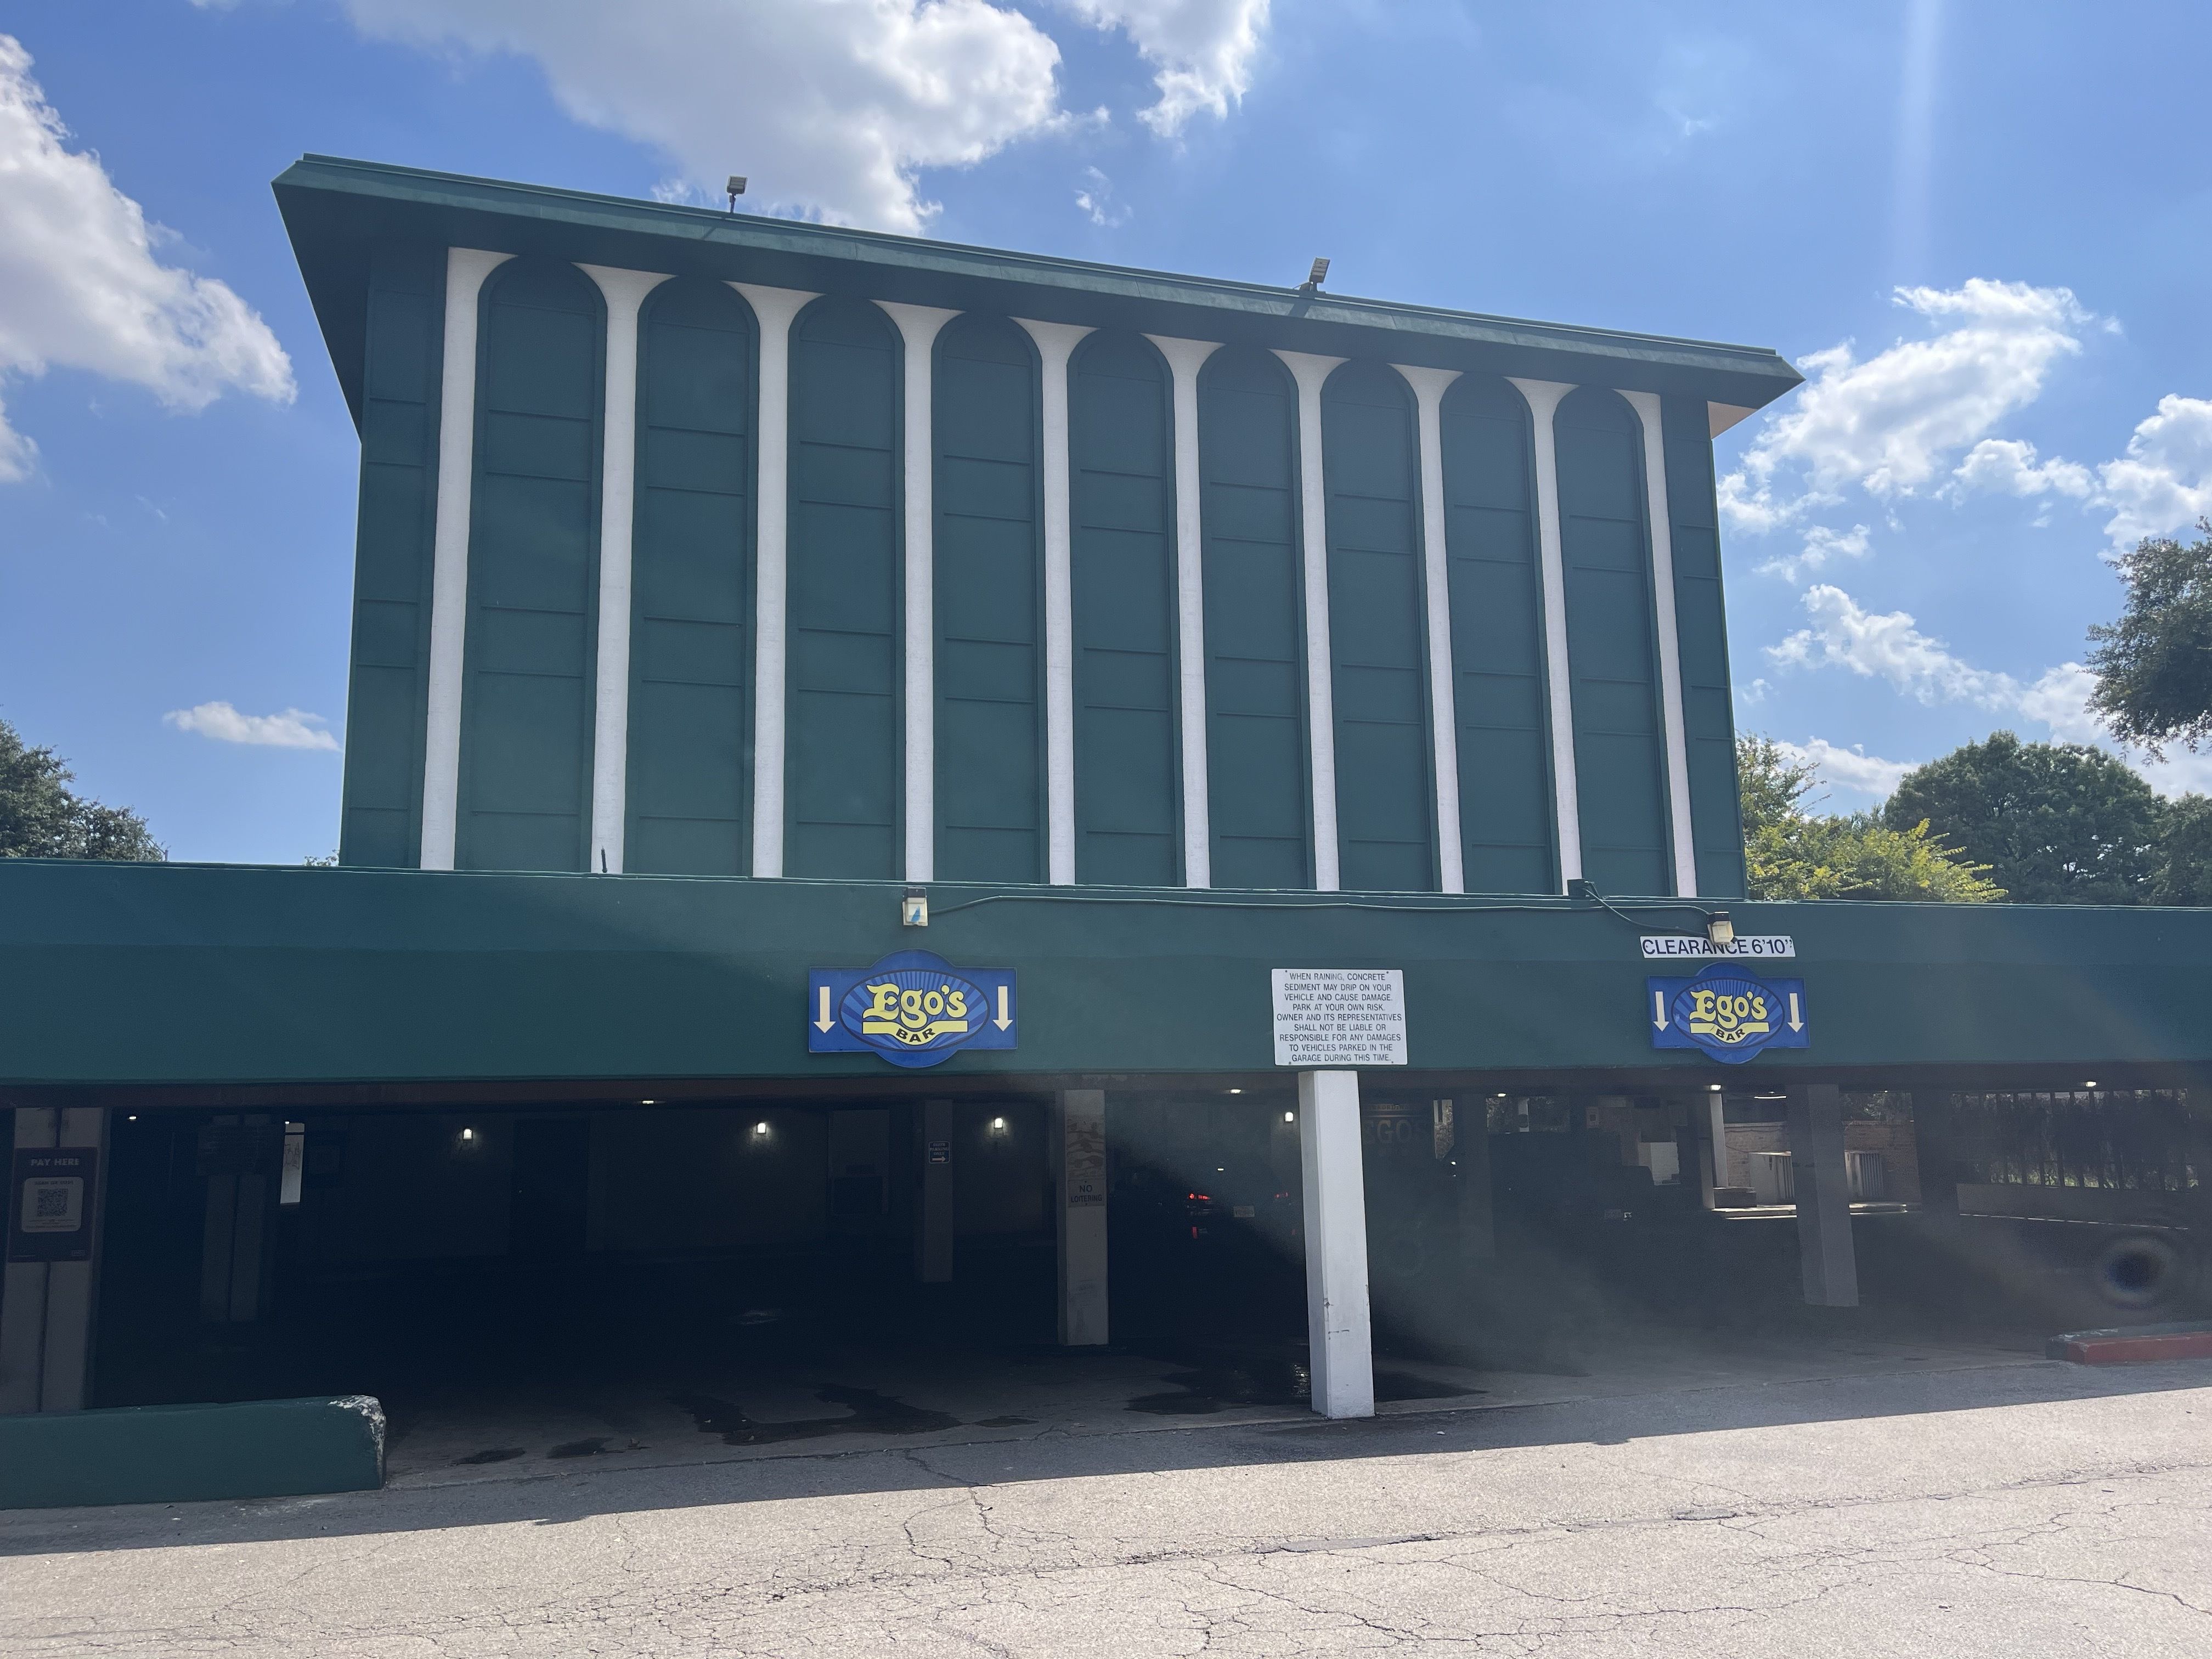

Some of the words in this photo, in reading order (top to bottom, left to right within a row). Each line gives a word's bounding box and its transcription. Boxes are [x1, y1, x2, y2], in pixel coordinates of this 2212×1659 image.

[1642, 939, 1749, 955] CLEARANCE
[862, 983, 968, 1029] Ego's
[1689, 989, 1768, 1029] Ego's
[896, 1028, 936, 1043] BAR
[1715, 1028, 1746, 1041] BAR
[31, 1158, 51, 1166] PAY
[1080, 1184, 1092, 1193] NO
[1070, 1194, 1103, 1203] LOITERING
